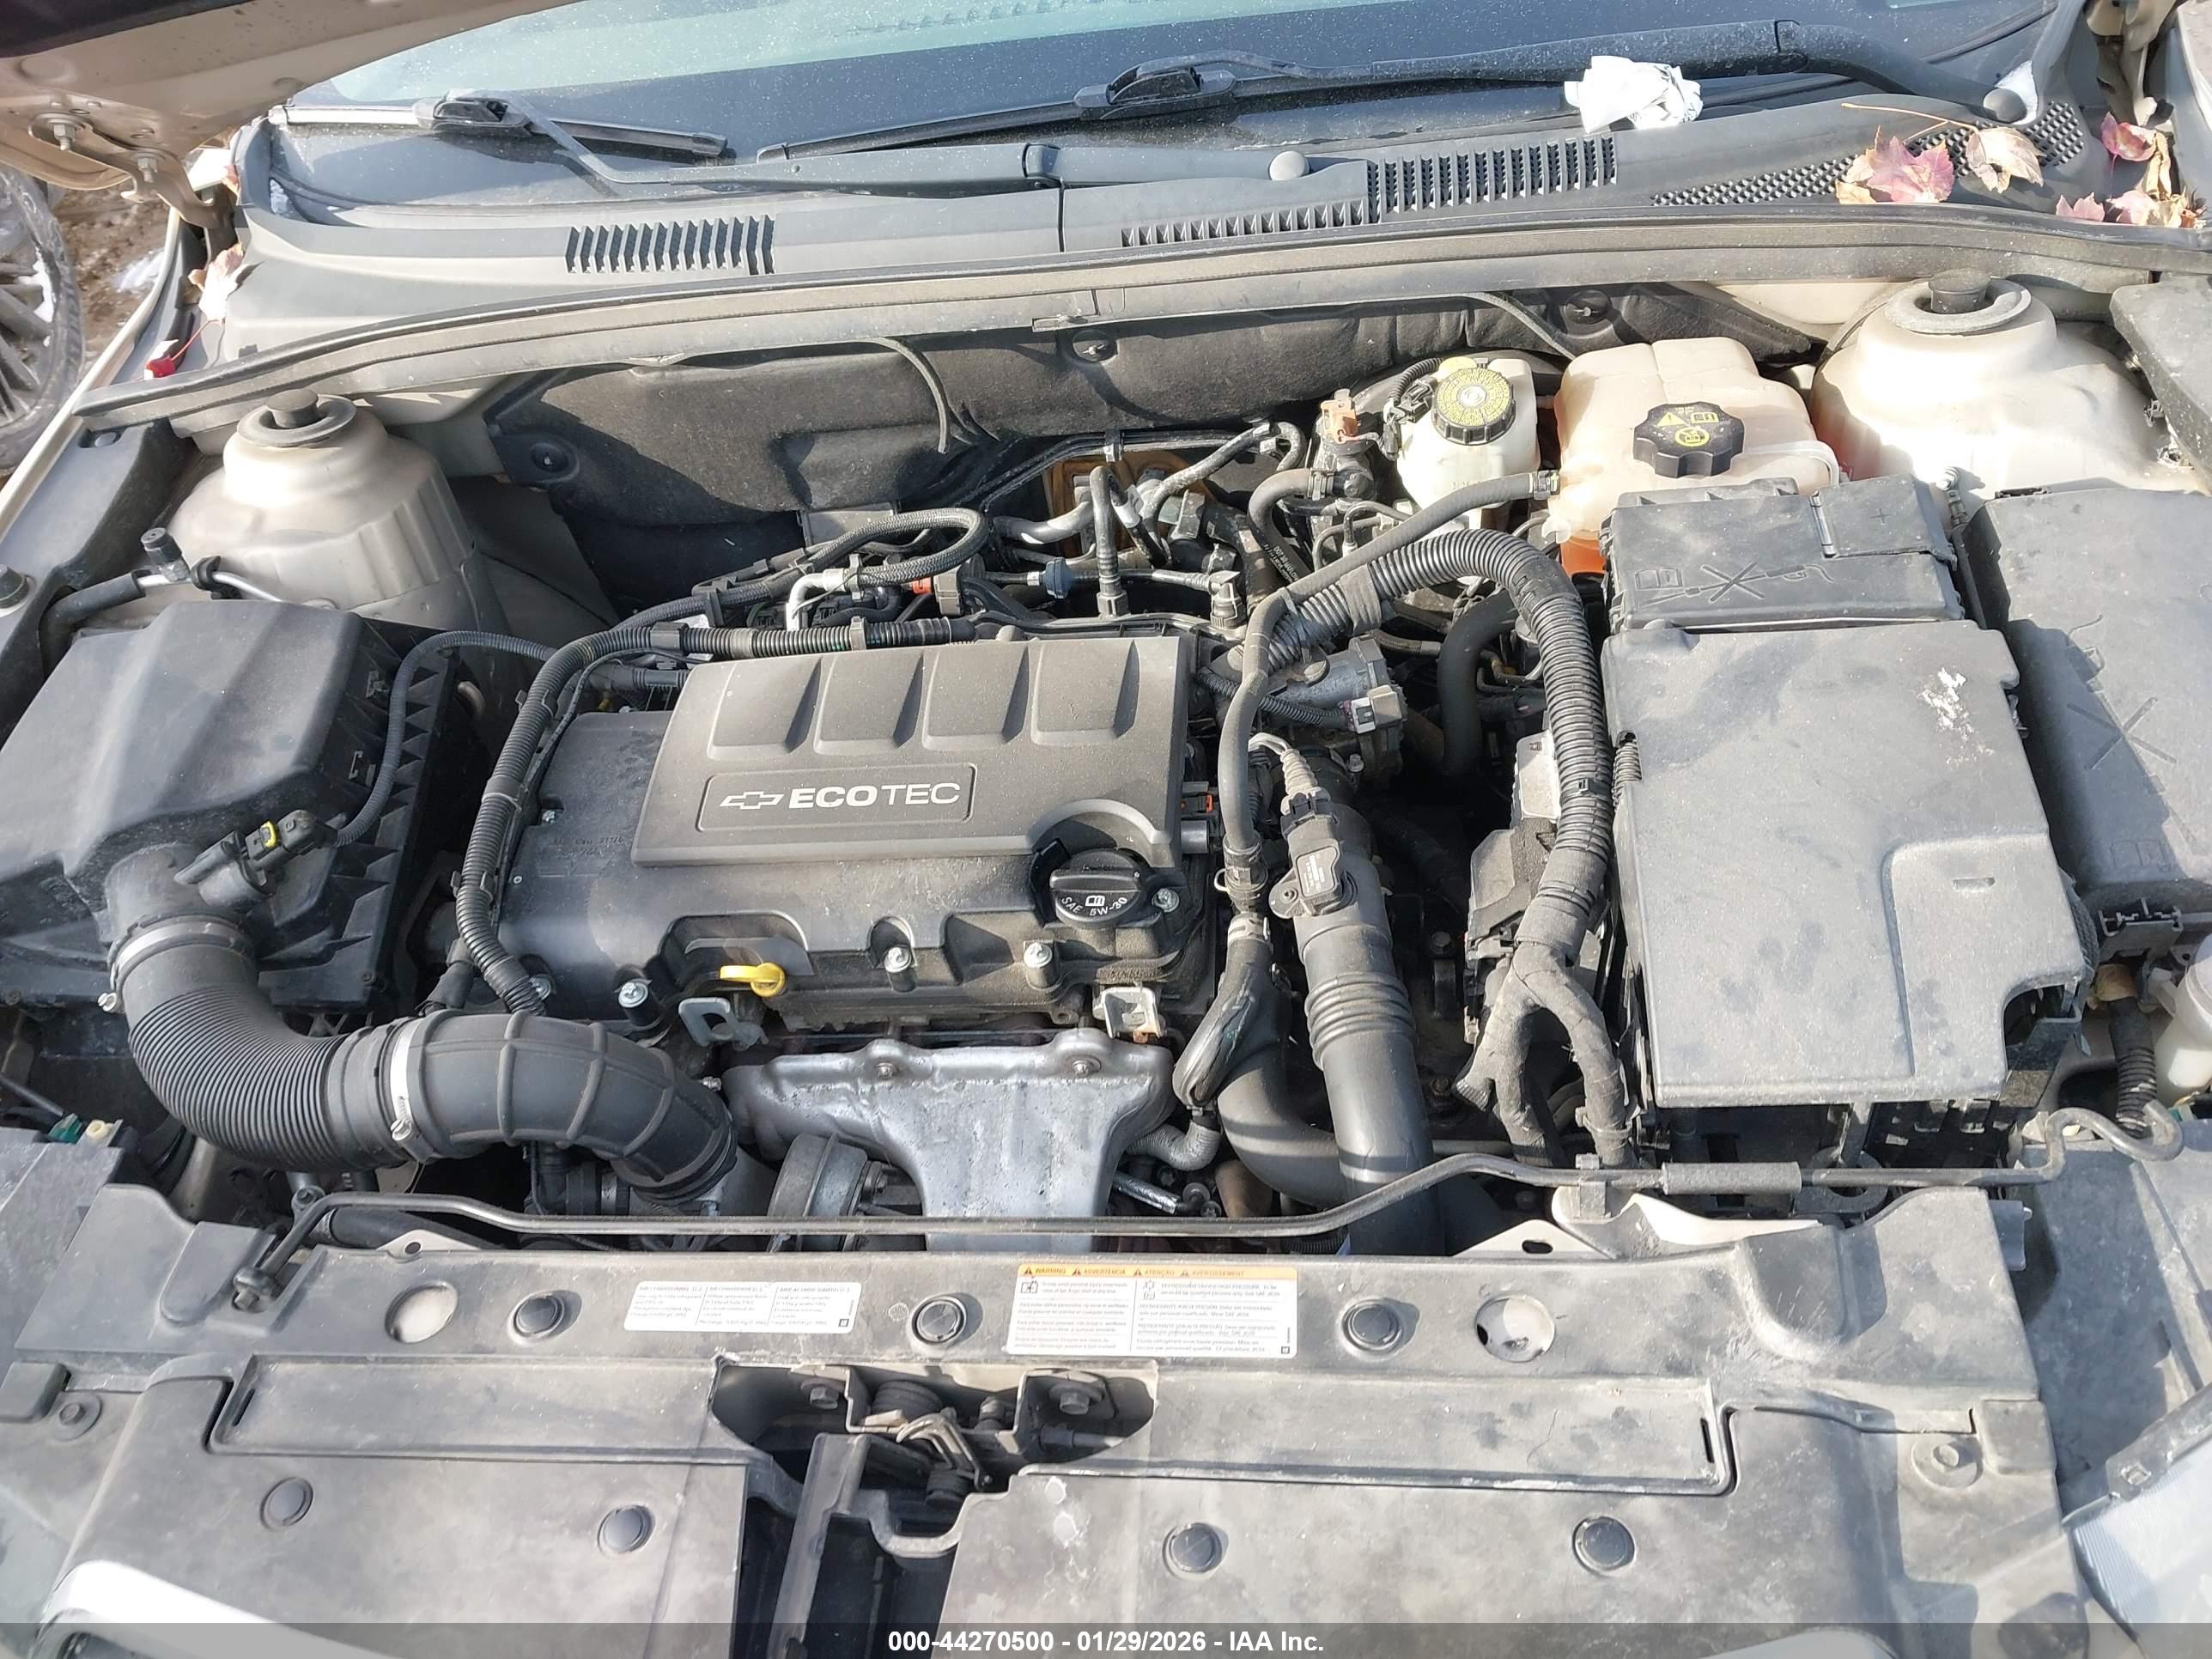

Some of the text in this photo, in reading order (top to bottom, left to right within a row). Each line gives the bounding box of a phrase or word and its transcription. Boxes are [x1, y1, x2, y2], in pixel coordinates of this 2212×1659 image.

[788, 782, 961, 809] ECOTEC
[1061, 896, 1127, 916] SAE 5W-30
[1035, 1267, 1066, 1275] WARNING
